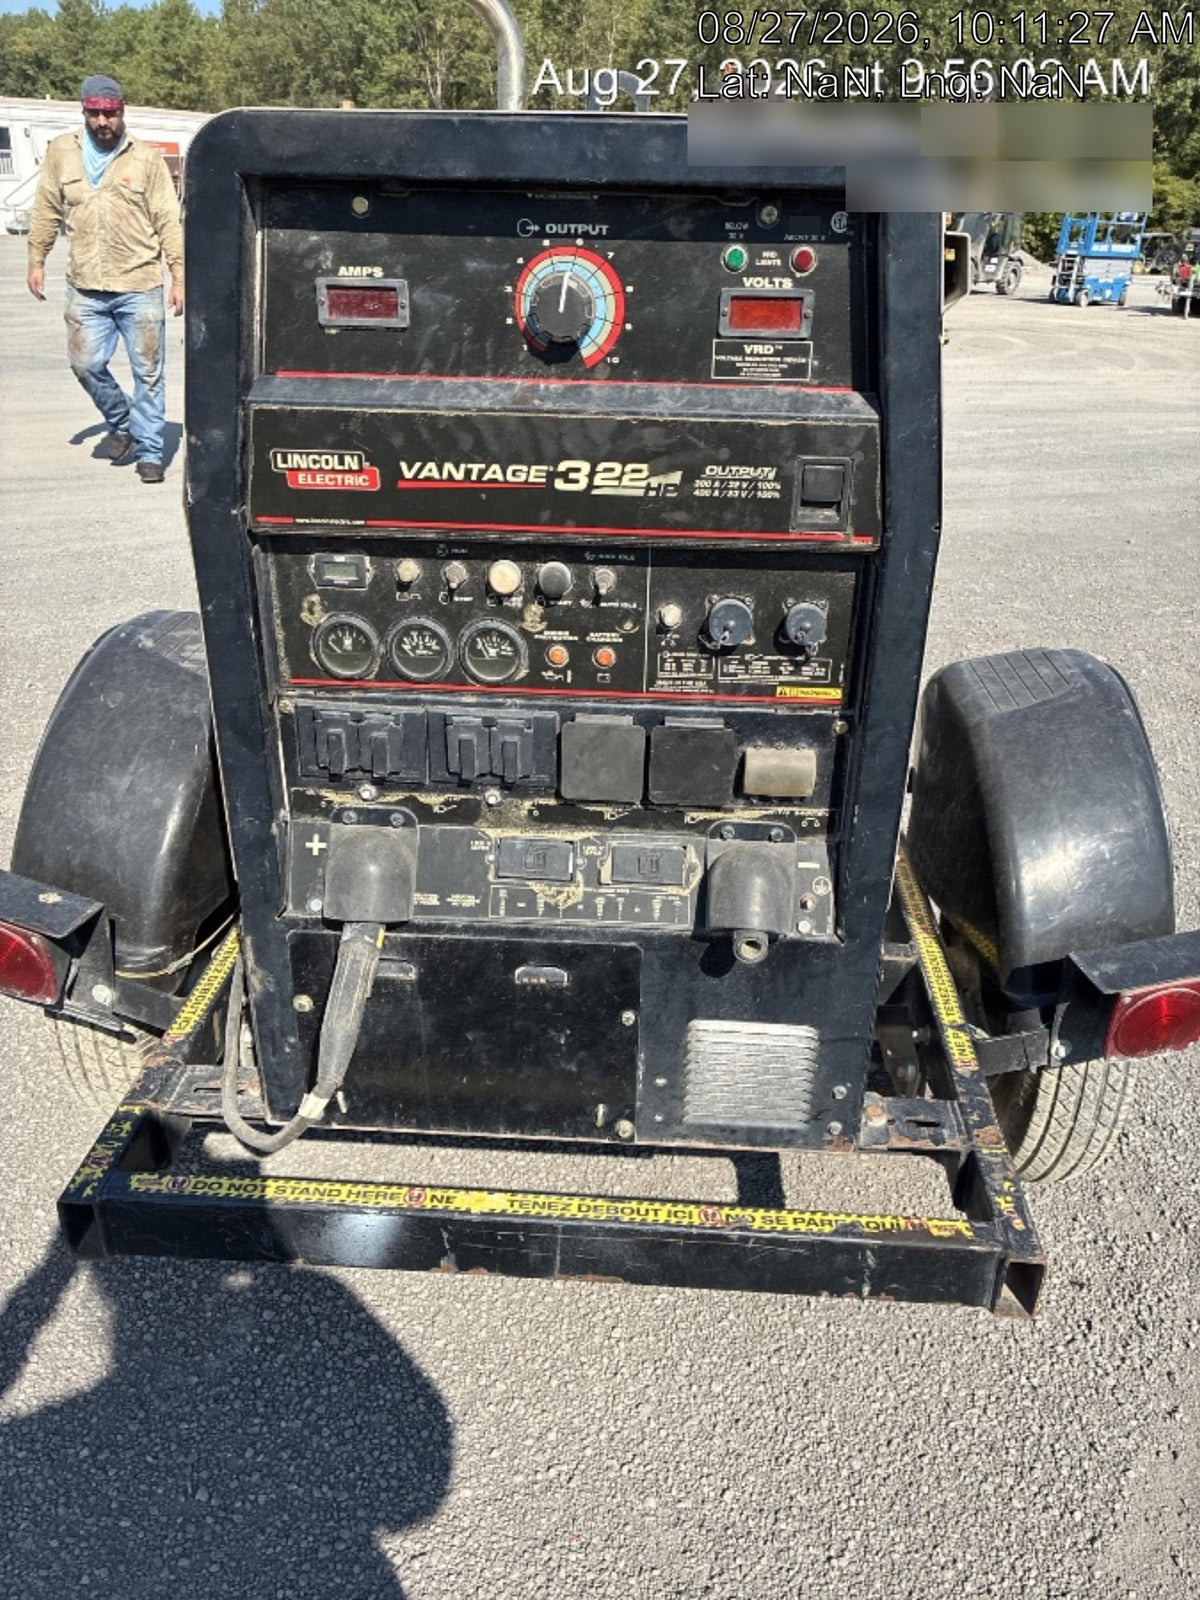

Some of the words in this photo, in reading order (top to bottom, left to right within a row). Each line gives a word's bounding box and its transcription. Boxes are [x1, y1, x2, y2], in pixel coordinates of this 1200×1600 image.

[545, 223, 610, 236] OUTPUT
[338, 266, 385, 278] AMPS
[742, 276, 793, 289] VOLTS
[276, 452, 360, 471] LINCOLN
[297, 473, 371, 487] ELECTRIC
[399, 460, 549, 483] VANTAGE
[554, 459, 651, 492] 322
[192, 1181, 223, 1194] DO
[226, 1183, 268, 1197] NOT
[273, 1185, 343, 1198] STAND
[346, 1188, 402, 1202] HERE
[508, 1199, 574, 1213] TENEZ
[577, 1203, 661, 1218] DEBOUT
[666, 1209, 694, 1220] ICI
[761, 1215, 788, 1227] SE
